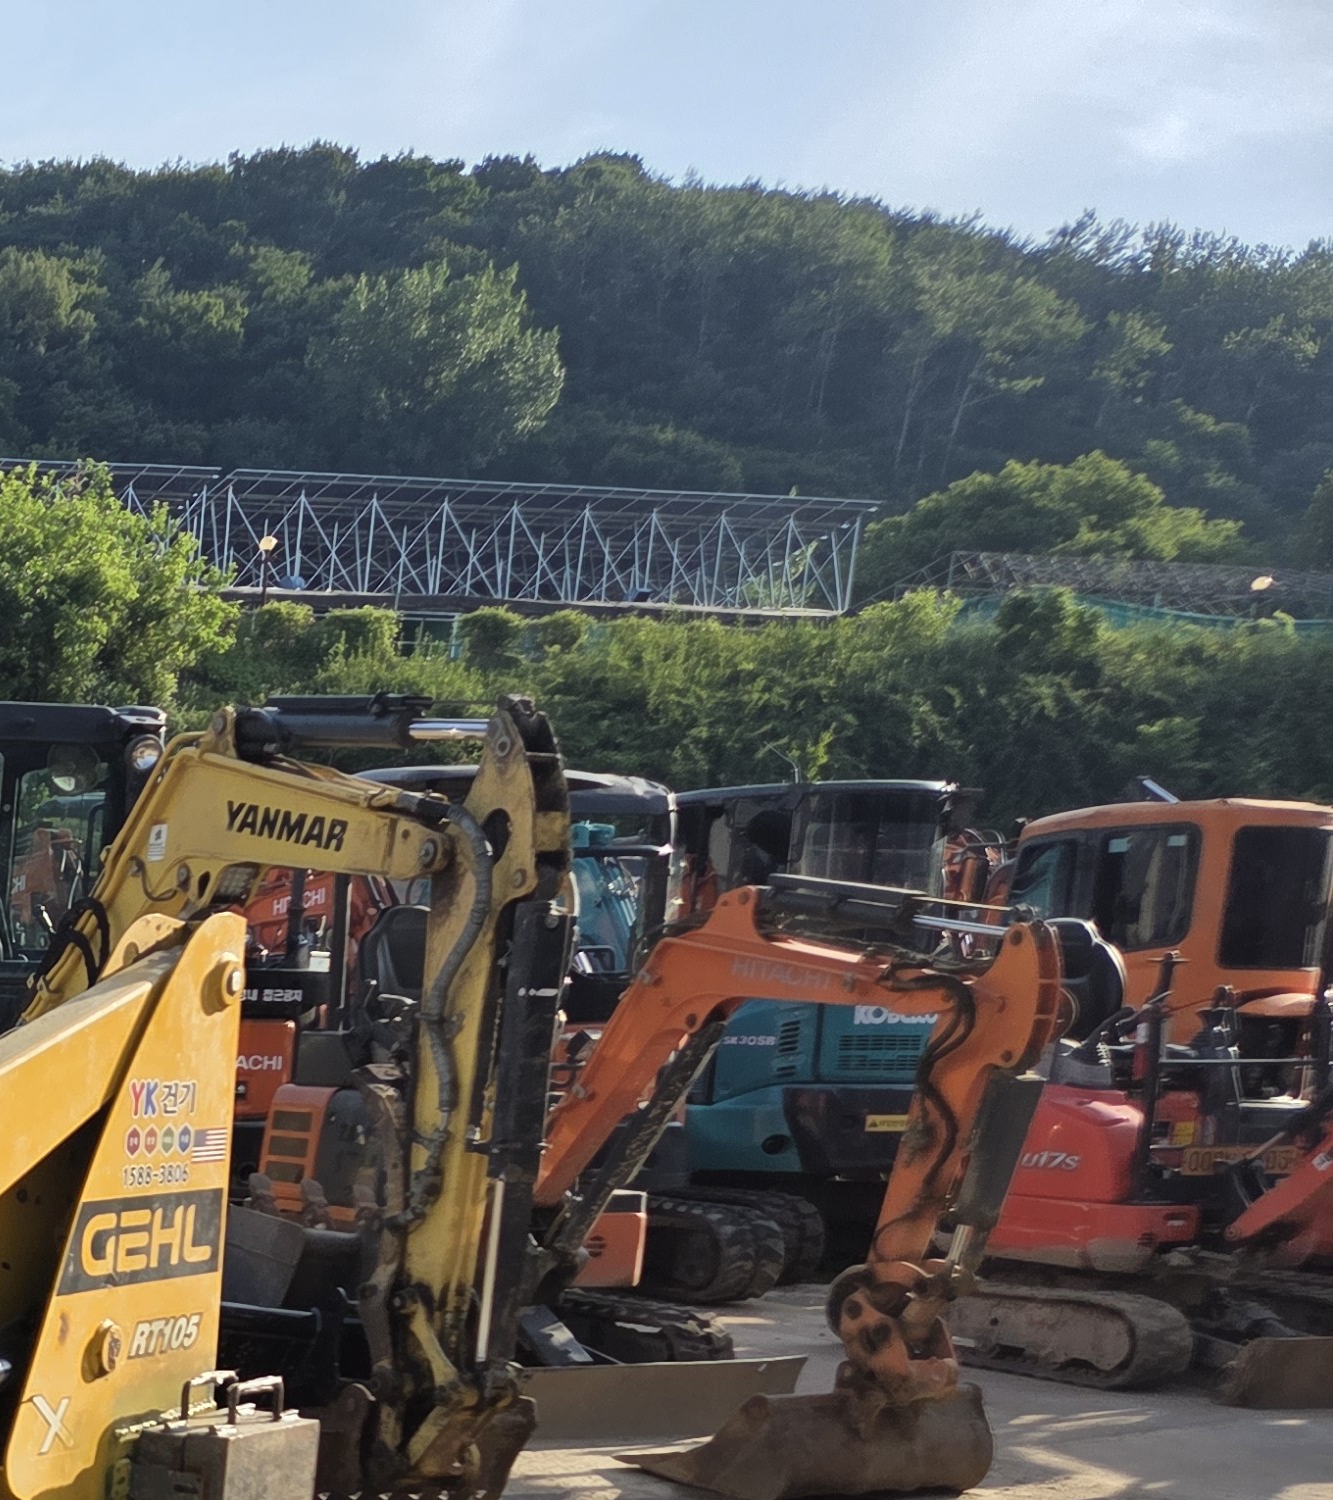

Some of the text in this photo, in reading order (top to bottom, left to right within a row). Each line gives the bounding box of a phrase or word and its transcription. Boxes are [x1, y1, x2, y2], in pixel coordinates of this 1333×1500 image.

[226, 800, 349, 852] YANMAR
[273, 887, 326, 916] HICHI
[730, 955, 831, 991] HITACHI
[236, 1055, 283, 1070] ACHI
[123, 1163, 189, 1186] 1588-3806
[81, 1204, 212, 1277] GEHL
[129, 1313, 203, 1359] RT105
